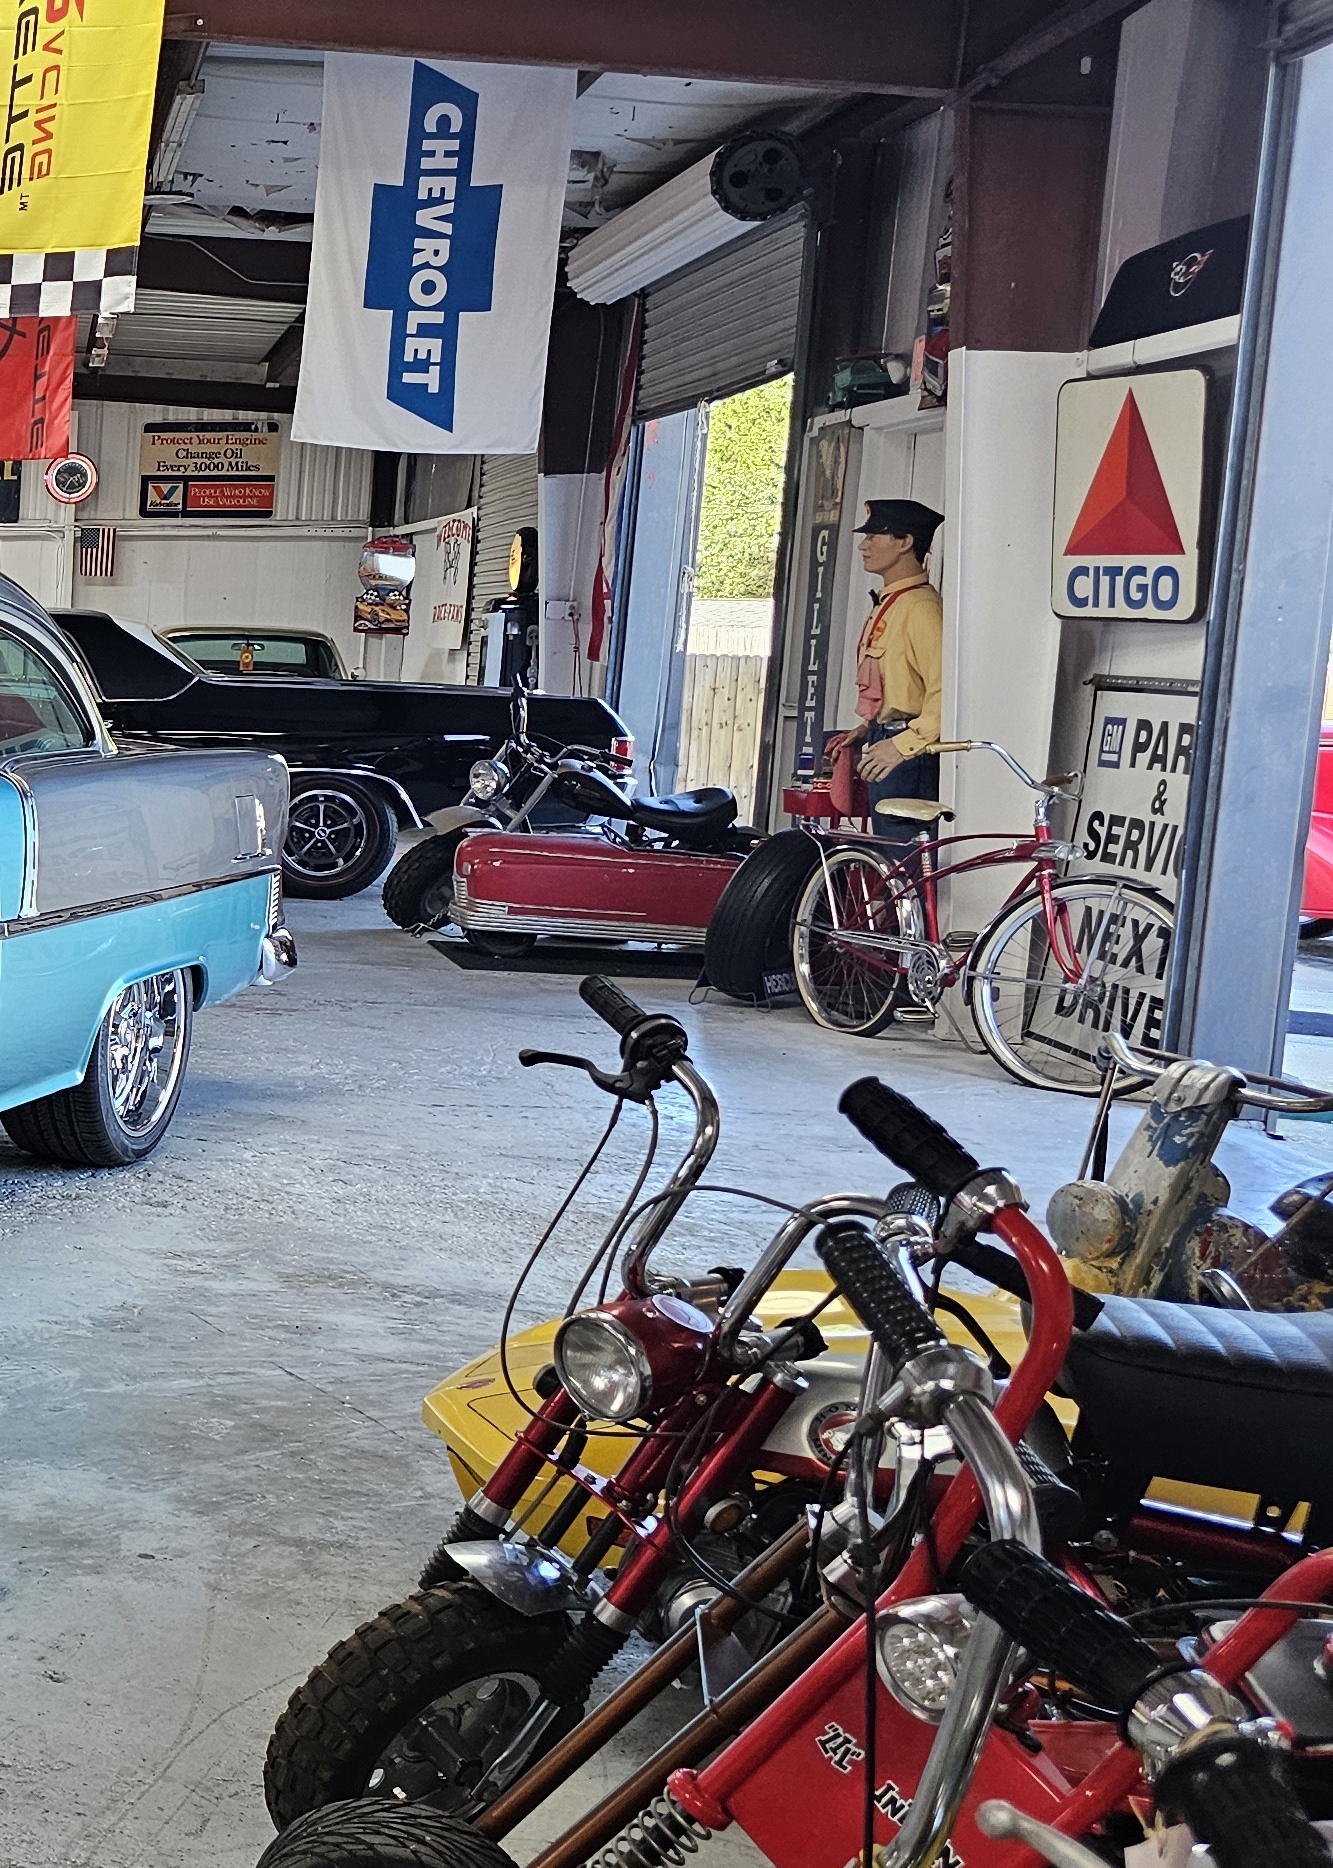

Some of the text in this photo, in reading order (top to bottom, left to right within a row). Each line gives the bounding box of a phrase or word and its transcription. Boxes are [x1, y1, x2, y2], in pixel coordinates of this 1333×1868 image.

[402, 102, 463, 393] CHEVROLET
[151, 434, 268, 447] Protect Your Engine
[175, 448, 243, 461] Change Oil
[156, 461, 260, 473] Every 3,000 Miles
[191, 487, 271, 496] PEOPLE WHO KNOW
[200, 497, 217, 505] USE
[436, 518, 471, 550] WELCOME
[1066, 565, 1180, 611] CITGO
[803, 529, 829, 752] GILLET
[1103, 723, 1123, 752] GM
[1150, 779, 1167, 816] &
